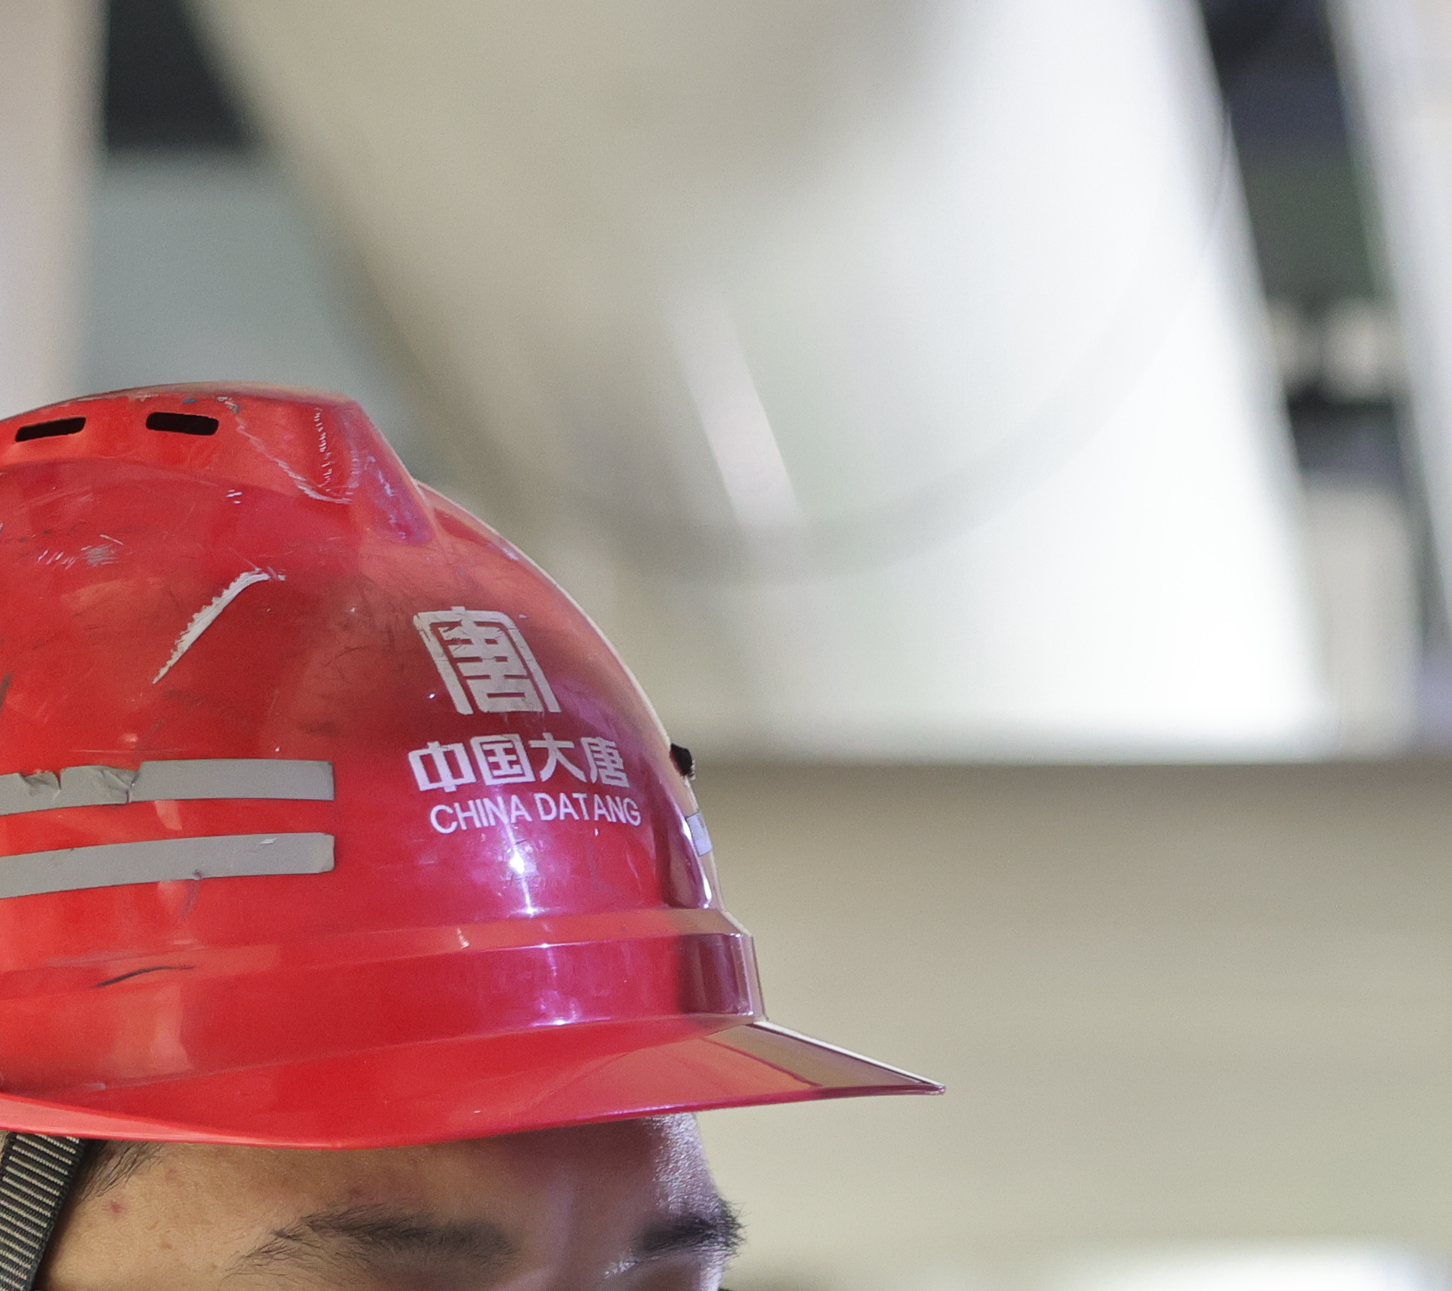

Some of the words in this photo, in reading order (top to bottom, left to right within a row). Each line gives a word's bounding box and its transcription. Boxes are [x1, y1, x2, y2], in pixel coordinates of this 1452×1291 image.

[408, 732, 630, 792] 中国大唐
[430, 794, 529, 834] CHINA
[537, 792, 642, 827] DATANG
